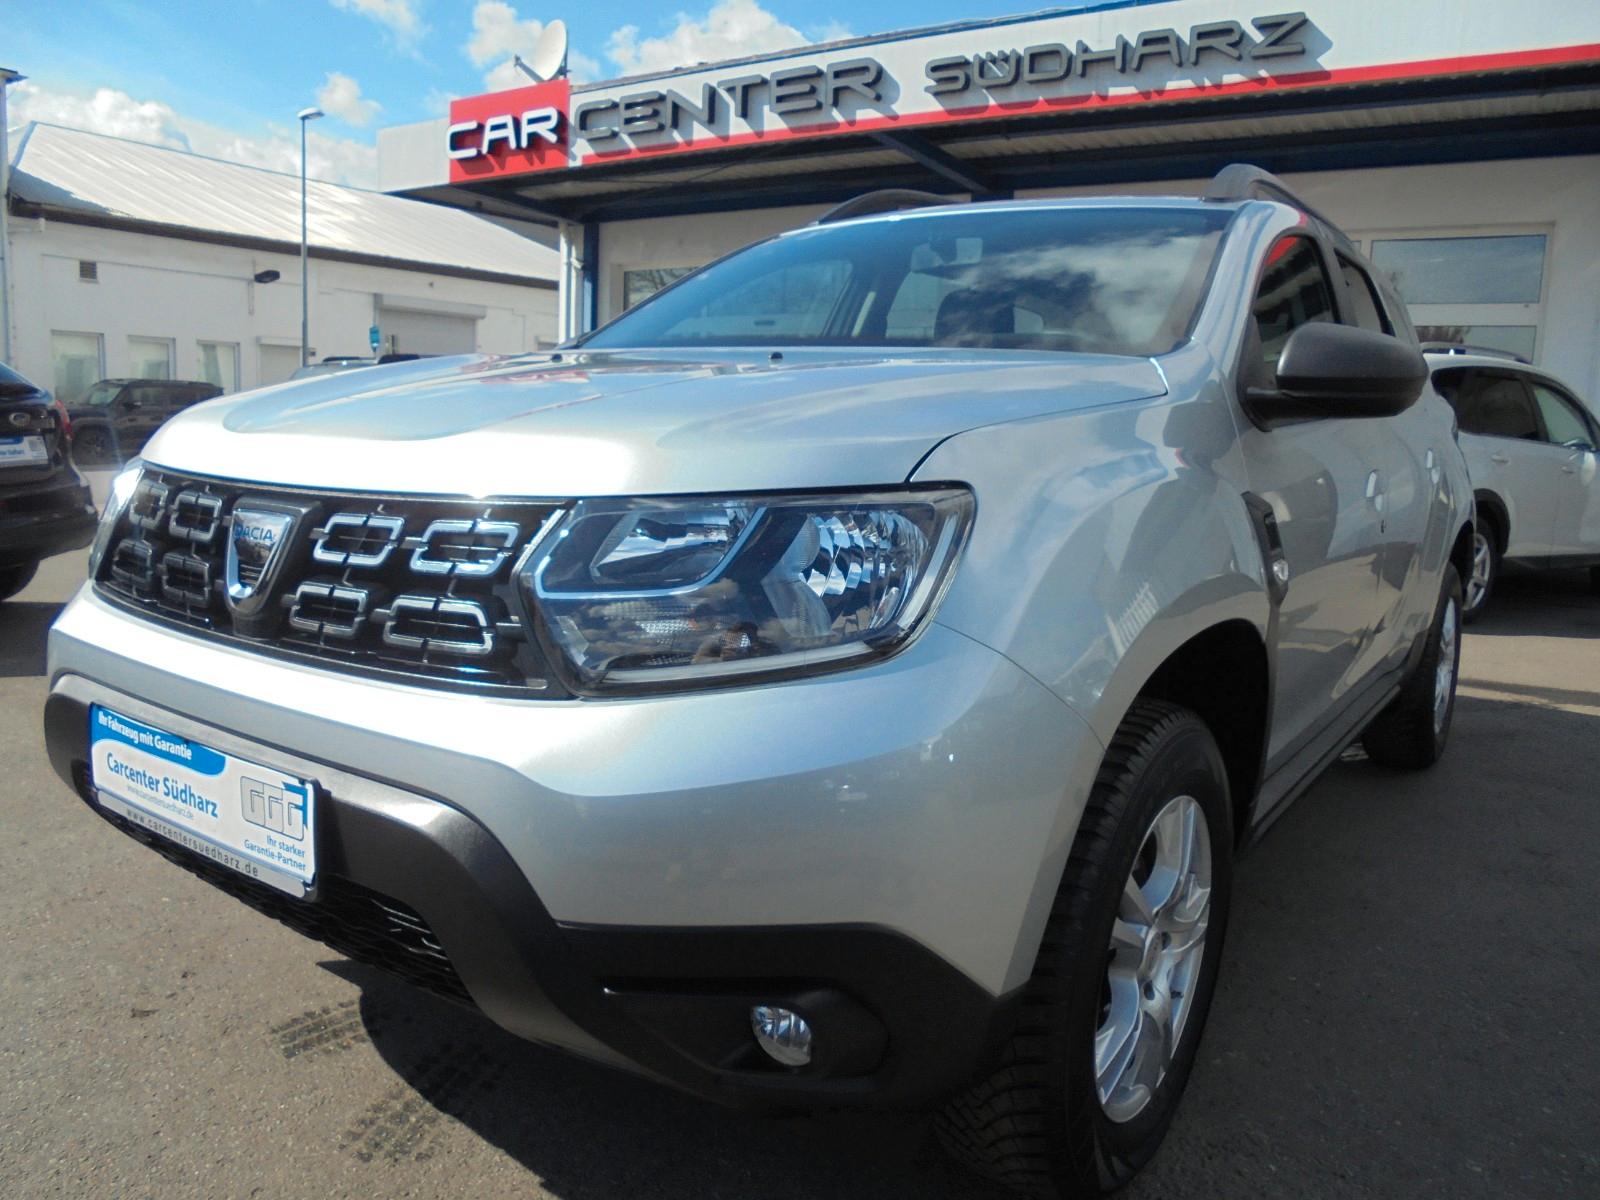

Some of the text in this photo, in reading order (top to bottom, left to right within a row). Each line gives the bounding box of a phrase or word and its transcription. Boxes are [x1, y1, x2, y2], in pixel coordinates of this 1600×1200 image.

[446, 12, 1307, 159] CAR CENTER SÜDHARZ
[234, 523, 273, 541] DACIA
[107, 715, 139, 744] Fahrzeug
[139, 732, 154, 747] mit
[154, 735, 192, 760] Garantie
[107, 752, 160, 792] Carcenter
[163, 776, 218, 818] Südharz
[127, 808, 259, 877] www.carcentersuedharz.de
[244, 839, 306, 871] Garantie-Partner
[266, 835, 305, 858] Ihr starker
